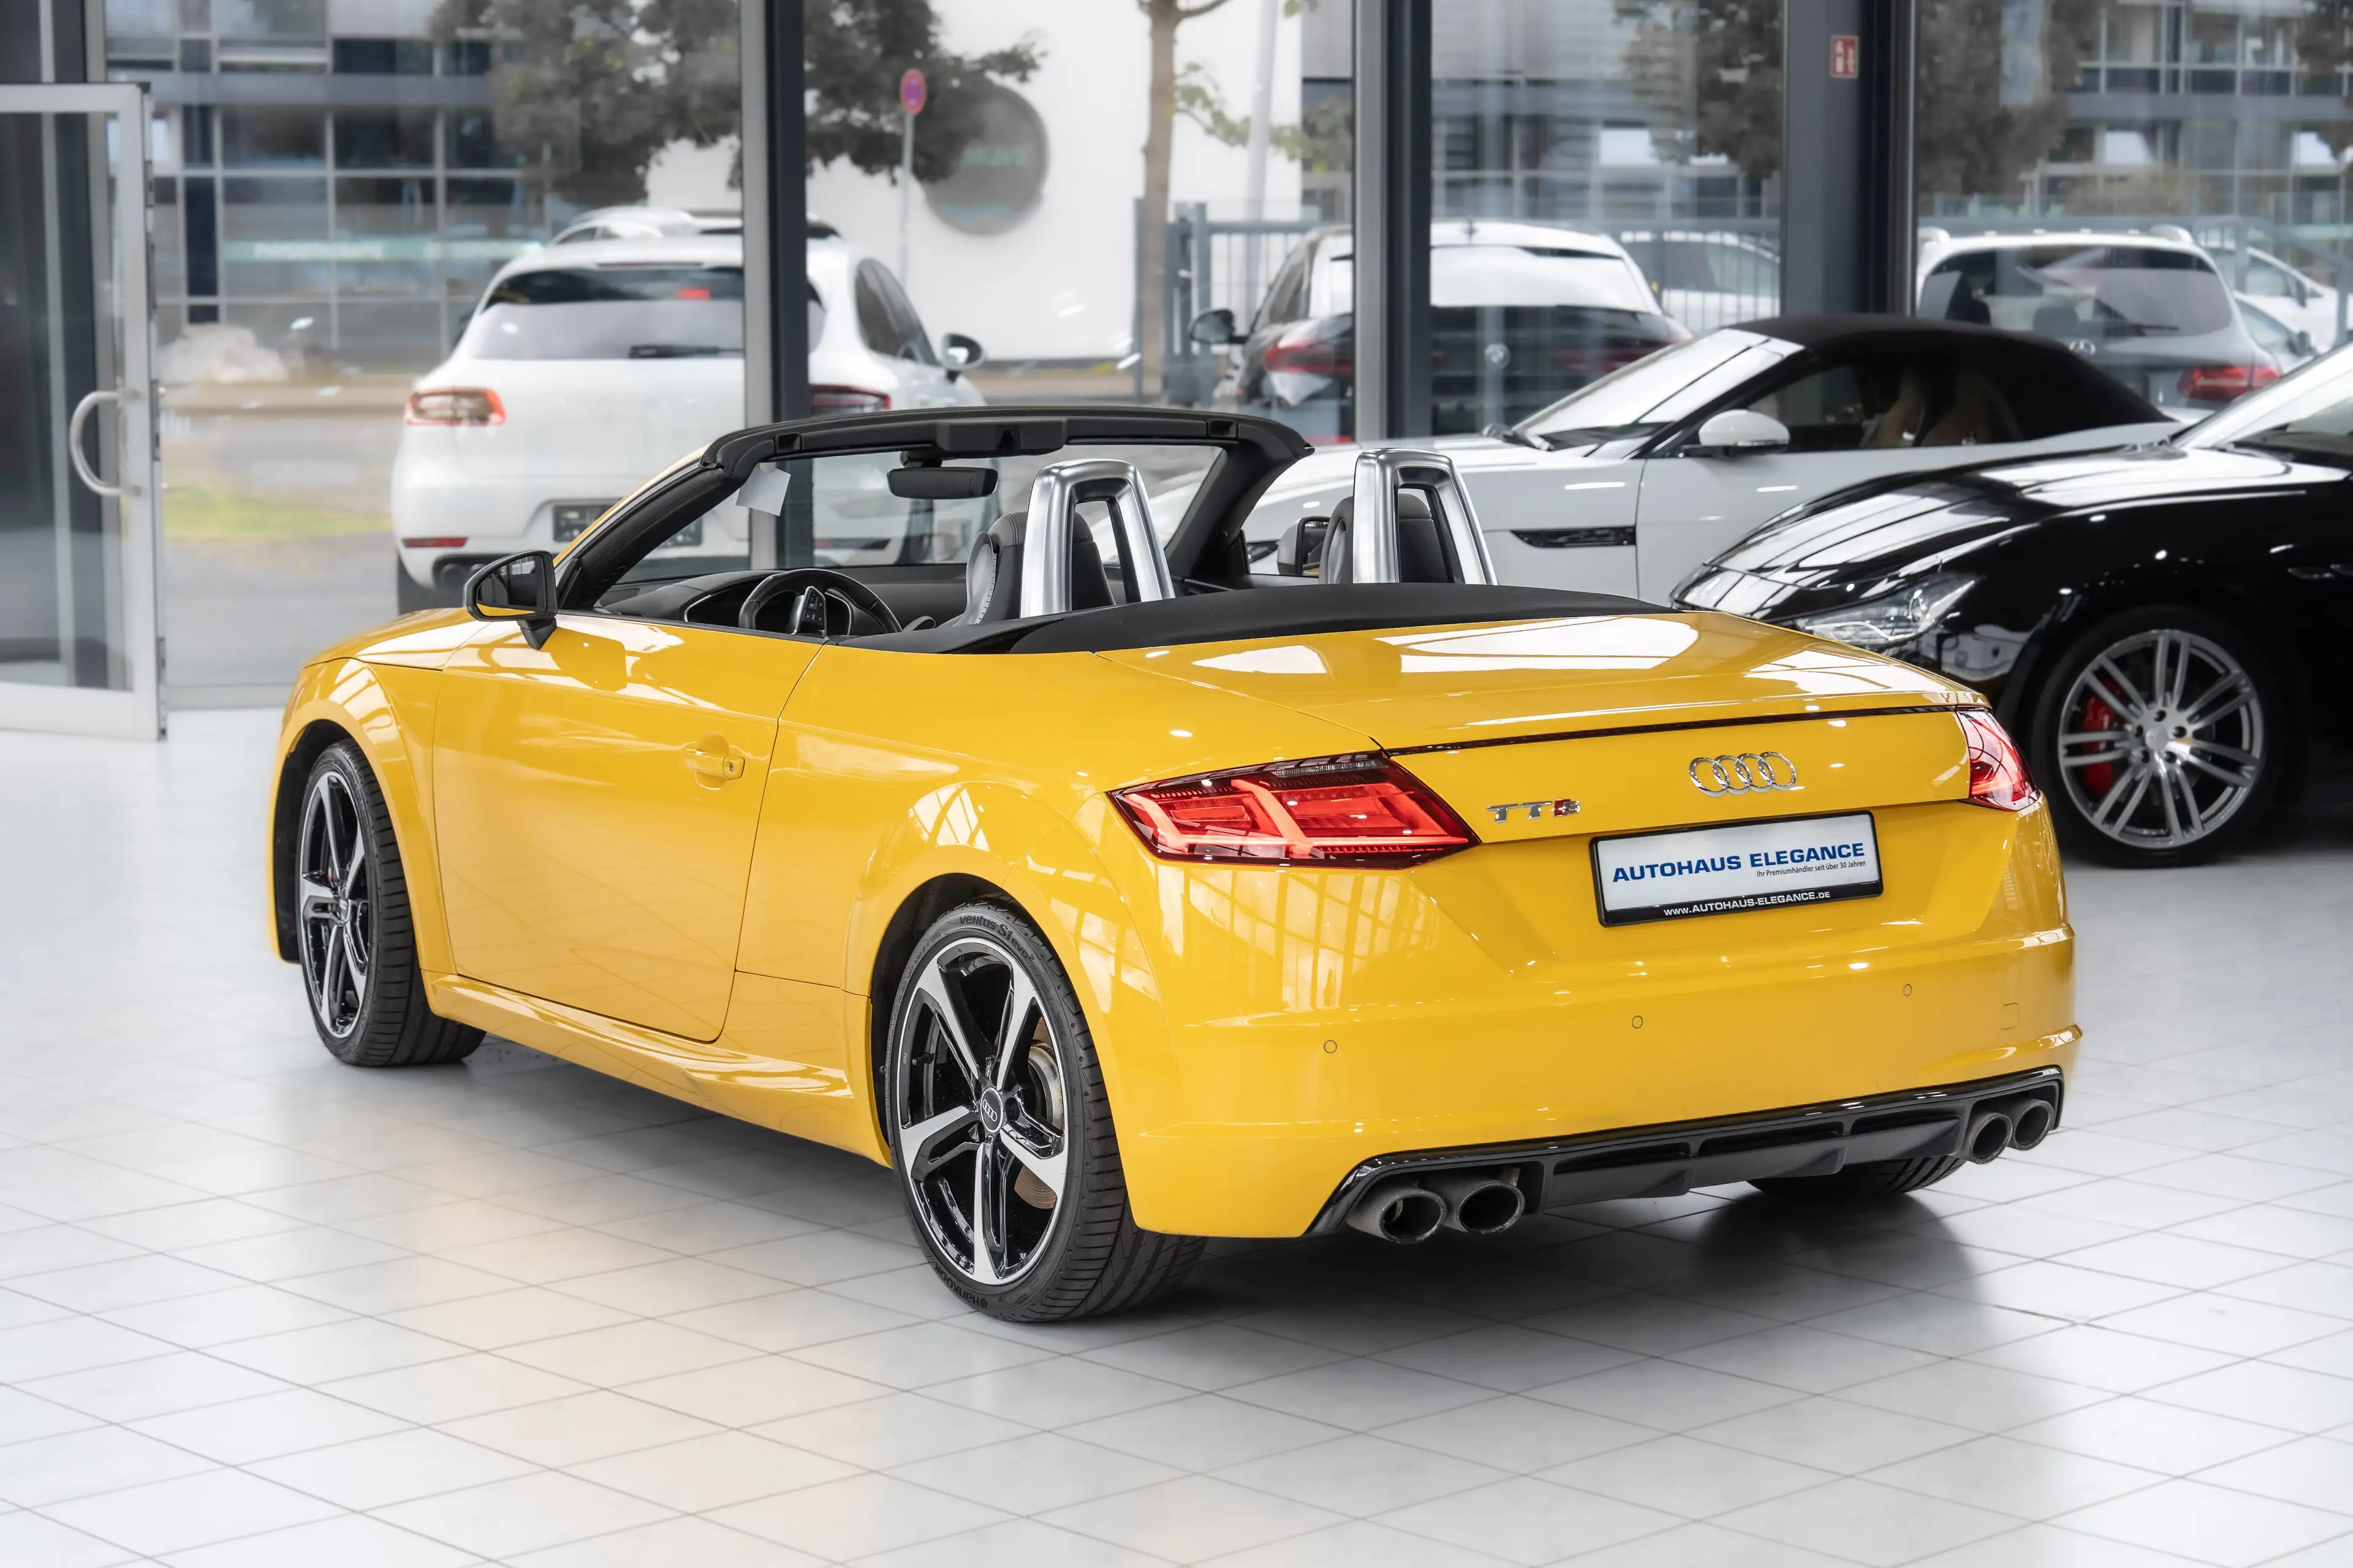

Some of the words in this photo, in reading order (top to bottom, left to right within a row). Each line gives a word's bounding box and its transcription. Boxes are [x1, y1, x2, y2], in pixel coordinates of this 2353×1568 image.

[1486, 798, 1581, 824] TTS
[1613, 855, 1742, 882] AUTOHAUS
[1749, 843, 1865, 868] ELEGANCE
[1766, 865, 1814, 876] Premiumhändler
[1847, 860, 1866, 868] Jahren
